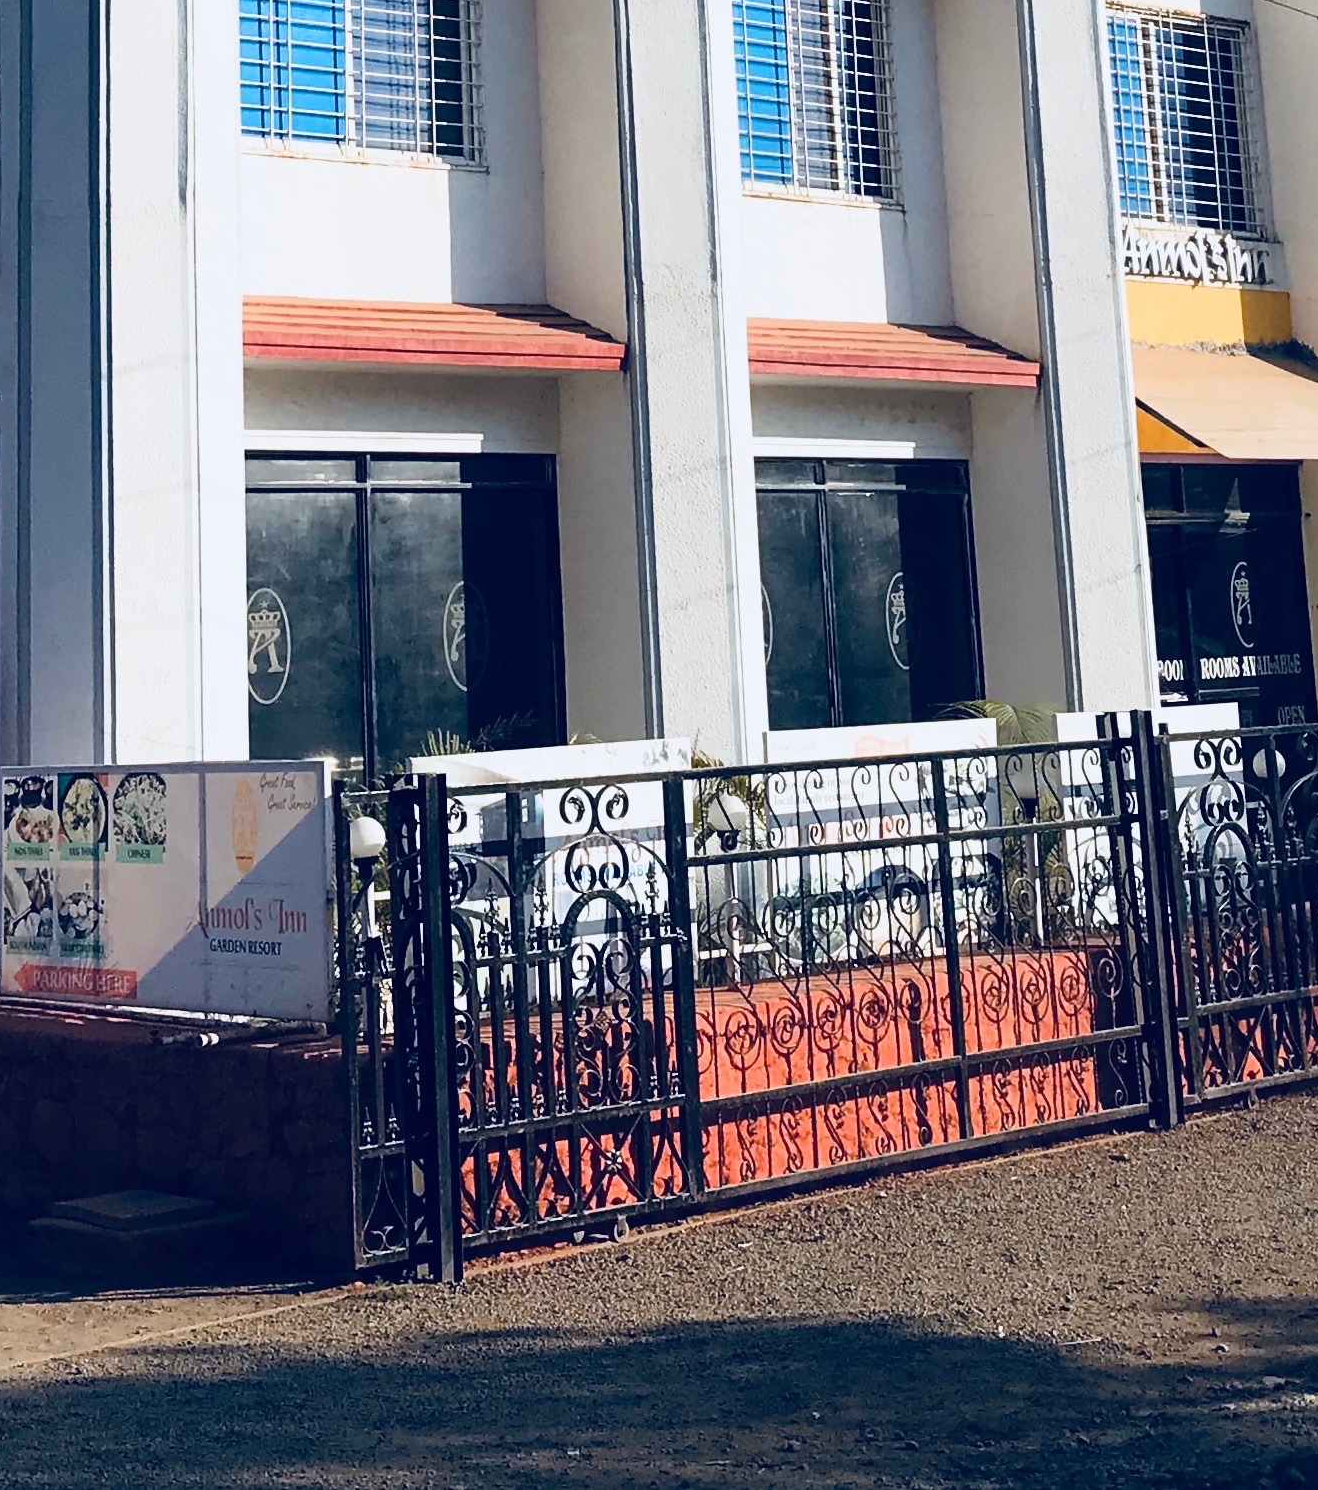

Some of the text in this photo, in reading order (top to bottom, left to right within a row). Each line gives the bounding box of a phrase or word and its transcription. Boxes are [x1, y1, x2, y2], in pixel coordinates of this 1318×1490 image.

[1200, 653, 1302, 680] ROOMS AVAILABLE
[1277, 705, 1306, 725] OPEN
[187, 898, 308, 938] Anmol's Inn
[210, 938, 283, 955] GARDEN RESORT
[33, 970, 131, 994] PARKING HERE
